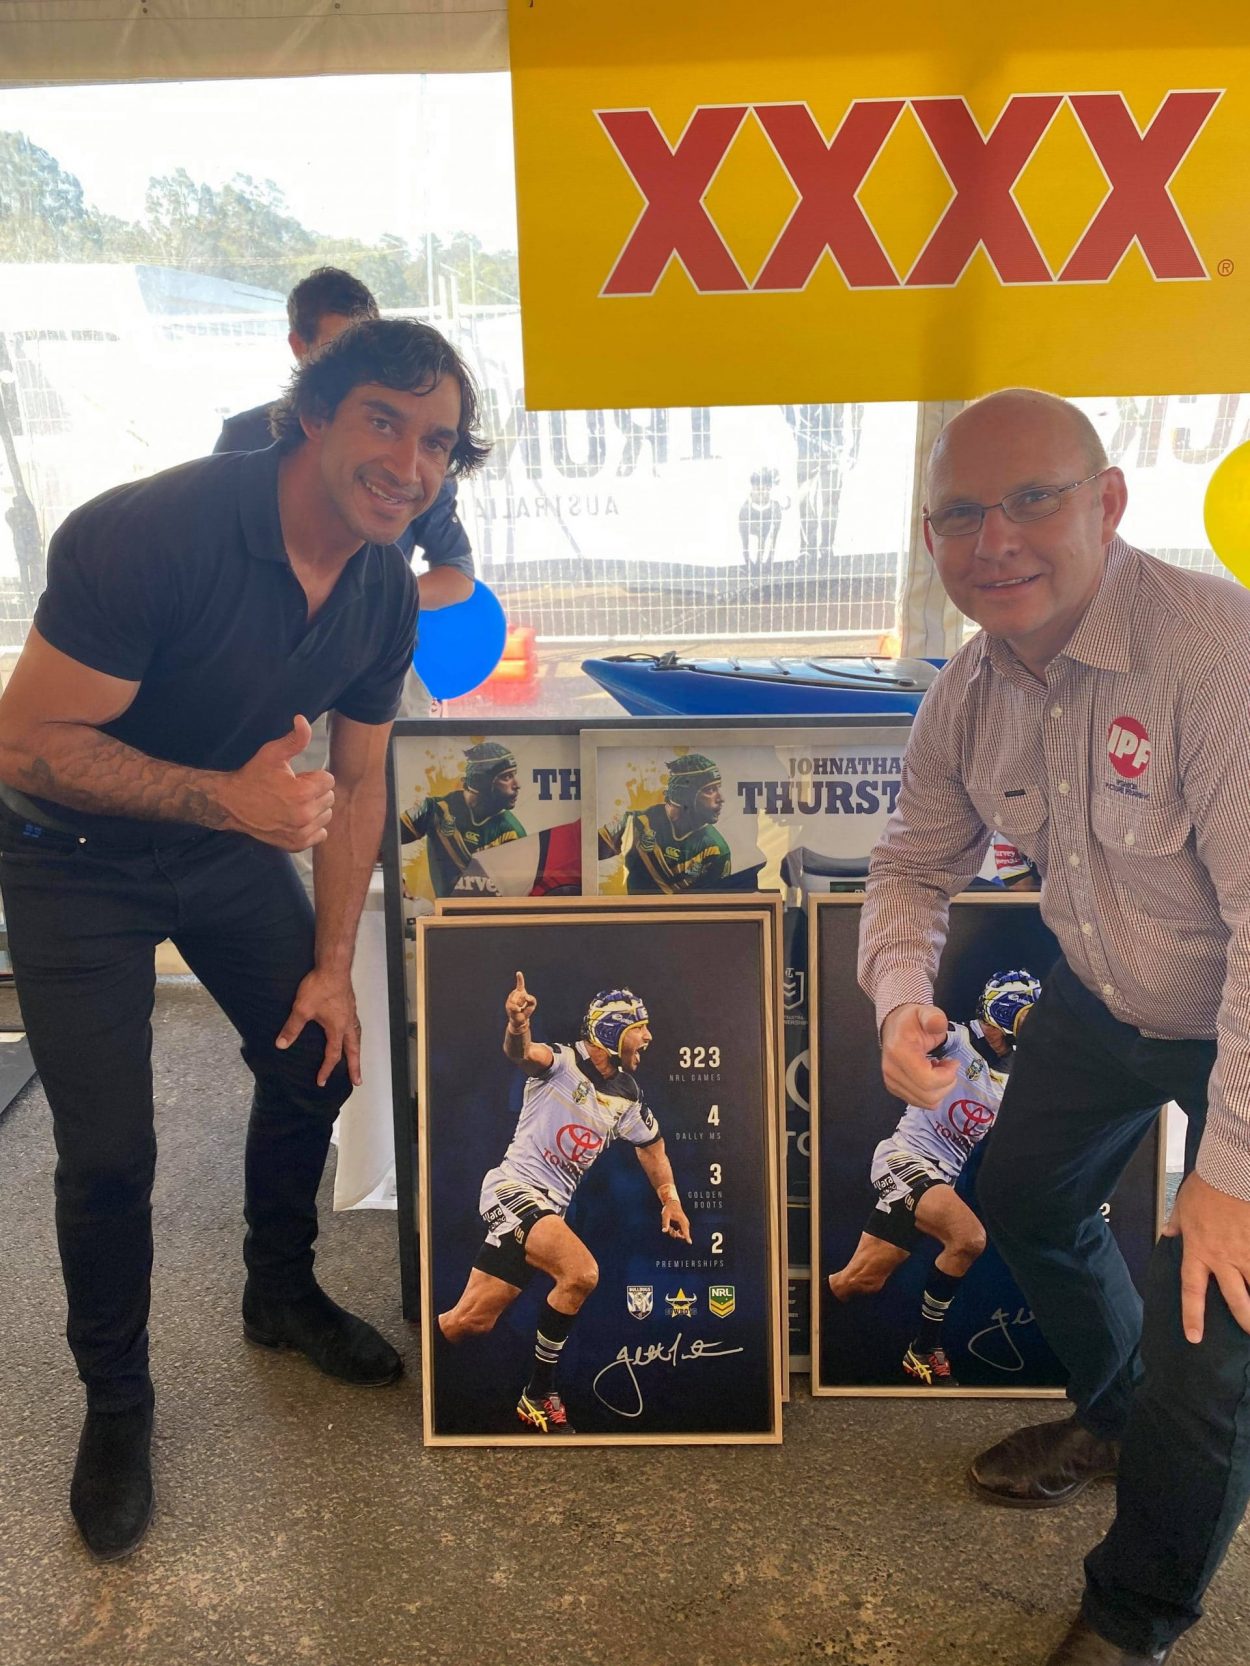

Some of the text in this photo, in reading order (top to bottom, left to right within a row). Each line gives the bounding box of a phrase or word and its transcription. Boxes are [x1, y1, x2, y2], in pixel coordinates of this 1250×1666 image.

[593, 89, 1227, 298] XXXX
[679, 1046, 721, 1069] 323
[669, 1073, 721, 1082] NRL GAMES
[707, 1104, 721, 1127] 4
[675, 1132, 703, 1141] DALLY
[710, 1163, 722, 1186] 3
[687, 1190, 723, 1200] GOLDEN
[694, 1200, 723, 1210] BOOTS
[711, 1231, 724, 1254] 2
[655, 1260, 725, 1269] PREMIERSHIPS
[712, 1288, 733, 1297] NRL
